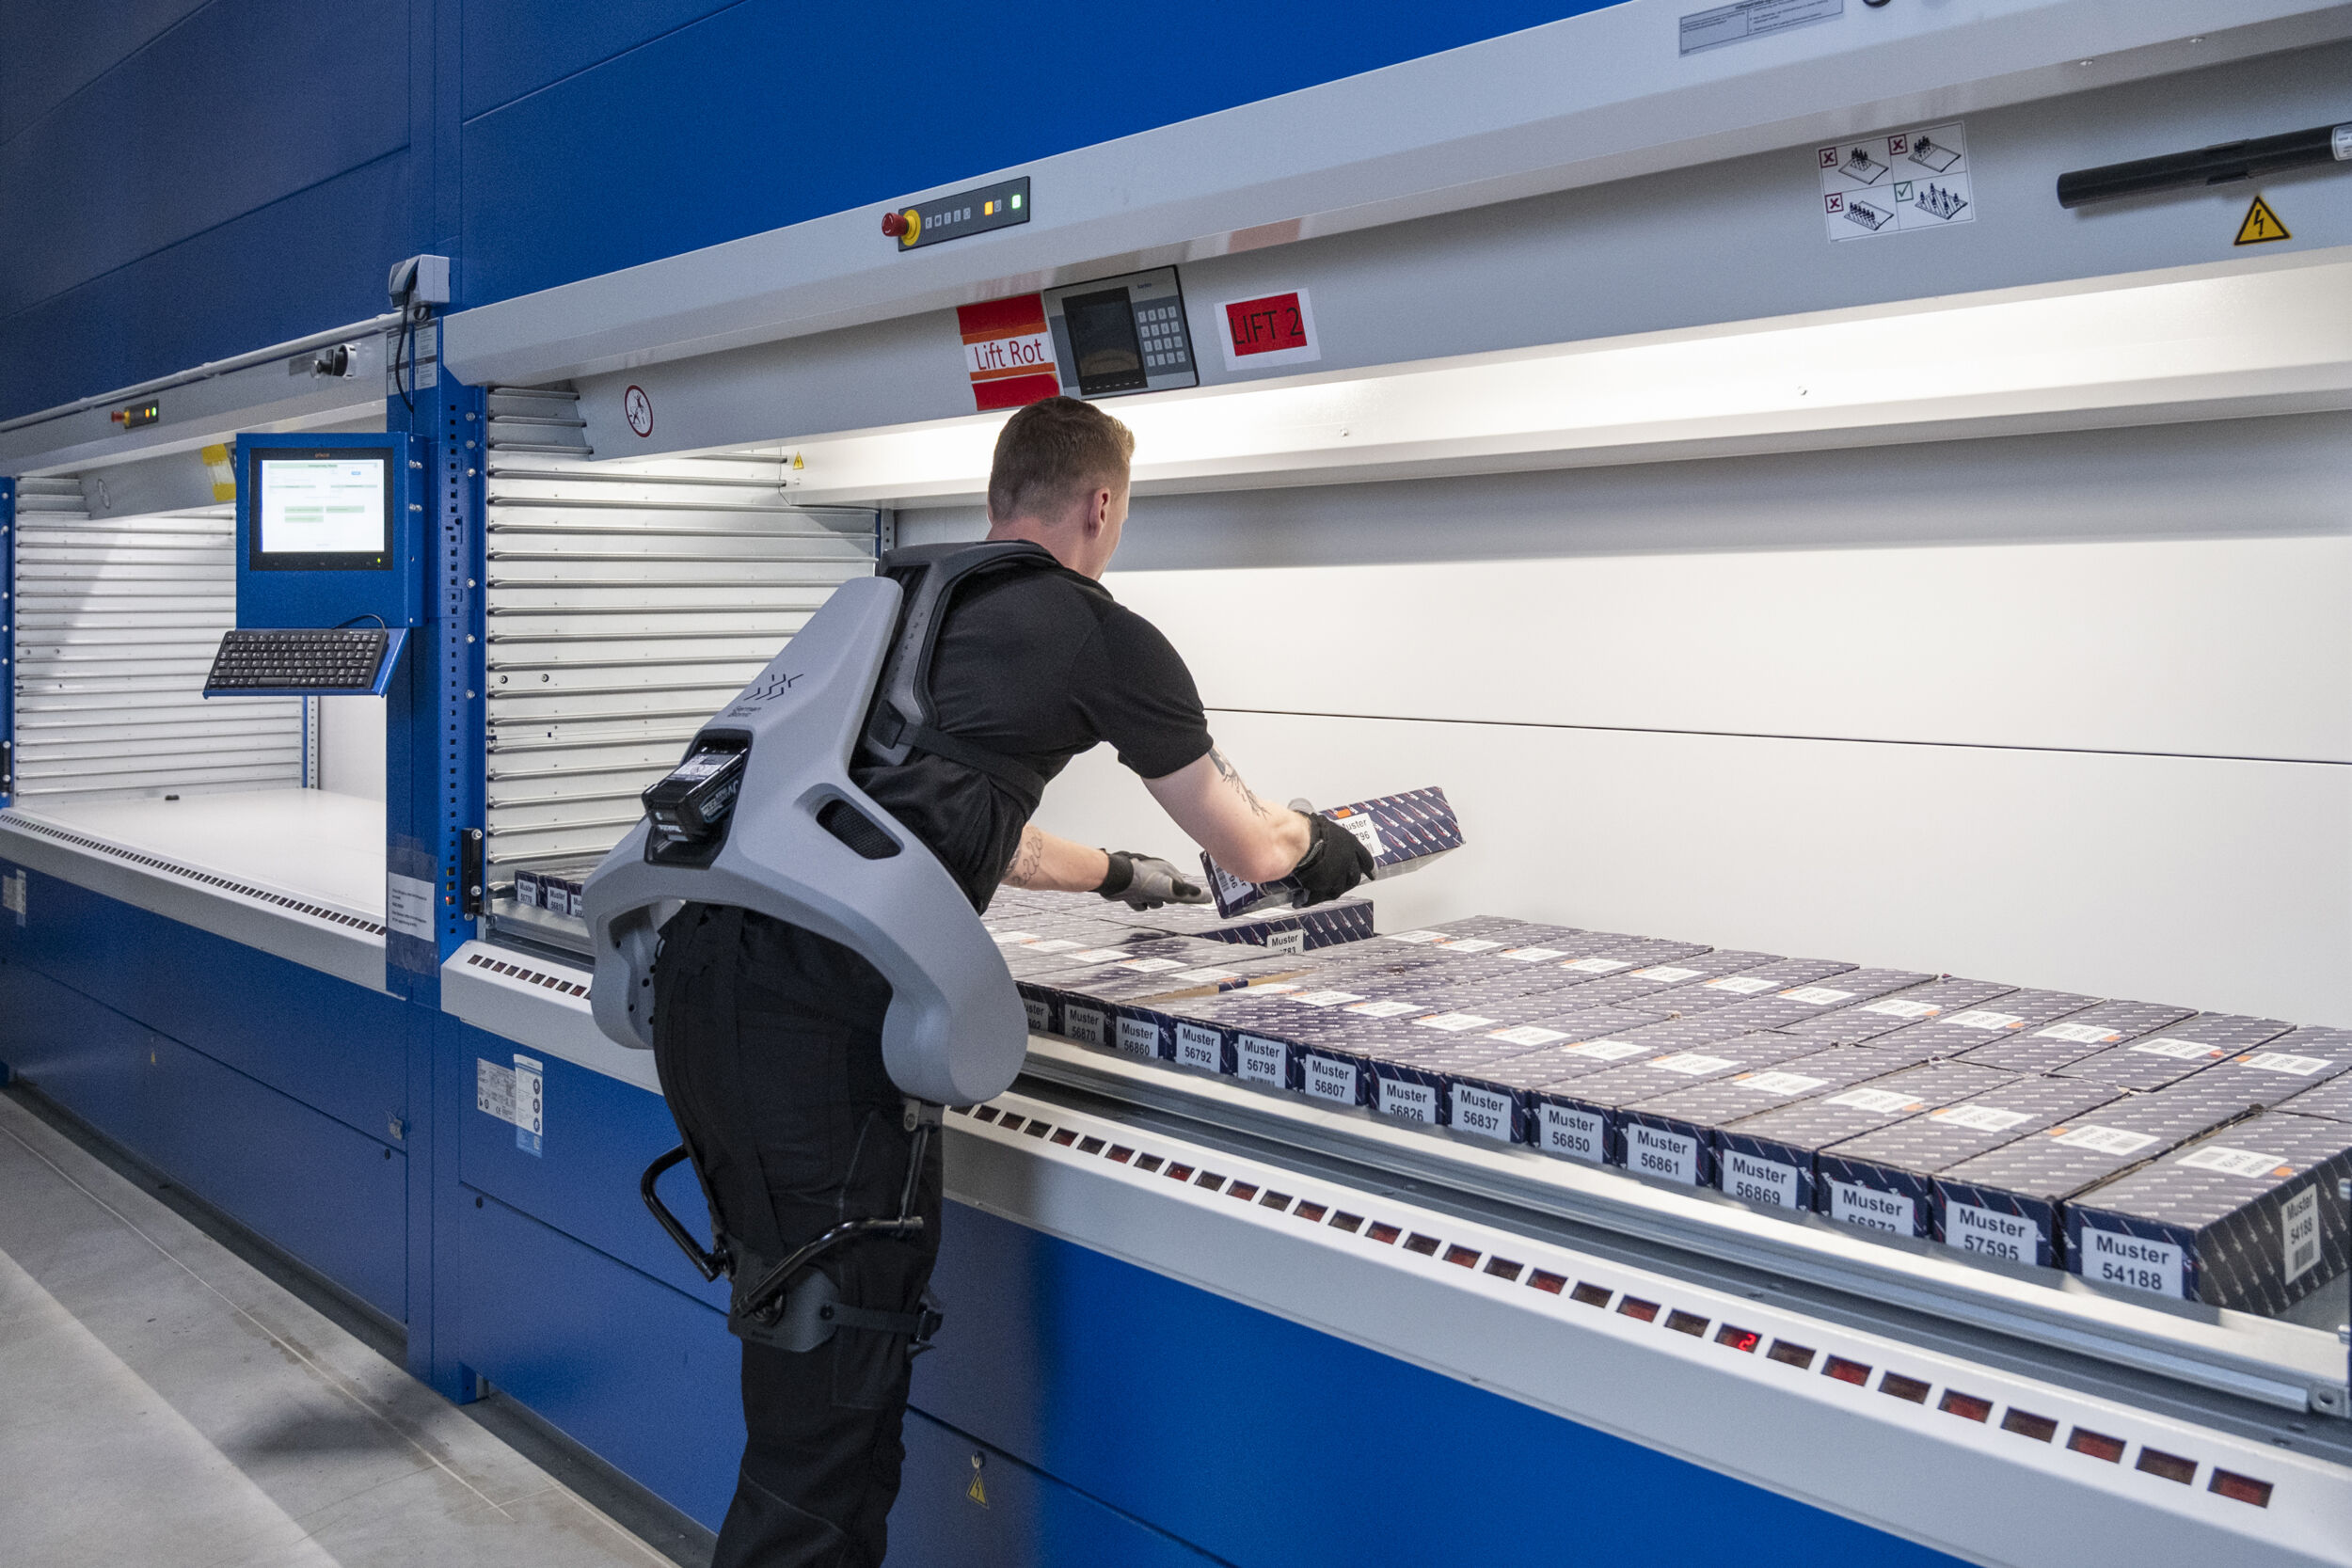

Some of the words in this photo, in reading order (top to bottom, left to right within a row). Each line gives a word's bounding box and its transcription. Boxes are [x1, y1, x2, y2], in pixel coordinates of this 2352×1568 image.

[1232, 310, 1279, 346] LIFT
[1290, 307, 1304, 337] 2
[974, 341, 1004, 372] Lift
[1009, 337, 1045, 366] Rot
[1355, 831, 1371, 841] 796
[519, 881, 533, 892] Muster
[1271, 934, 1298, 947] Muster
[1025, 1004, 1044, 1017] uster
[1070, 1009, 1099, 1025] Muster
[1072, 1026, 1096, 1041] 56870
[1121, 1023, 1153, 1039] Muster
[1183, 1028, 1216, 1047] Muster
[1123, 1040, 1150, 1055] 56860
[1184, 1045, 1212, 1064] 56792
[1245, 1038, 1280, 1059] Muster
[1247, 1057, 1277, 1076] 56798
[1312, 1060, 1349, 1082] Muster
[1314, 1079, 1345, 1099] 56807
[1387, 1083, 1427, 1104] Muster
[1460, 1089, 1504, 1113] Muster
[1390, 1103, 1423, 1122] 56826
[1463, 1110, 1499, 1132] 56837
[1549, 1109, 1595, 1133] Muster
[1552, 1131, 1590, 1153] 56850
[1637, 1131, 1688, 1156] Muster
[1641, 1153, 1679, 1175] 56861
[1732, 1157, 1787, 1185] Muster
[1736, 1181, 1781, 1205] 56869
[1843, 1189, 1903, 1217] Muster
[2286, 1194, 2313, 1220] Muster
[1959, 1208, 2026, 1238] Muster
[2290, 1216, 2313, 1244] 54188
[1963, 1233, 2019, 1261] 57595
[2096, 1234, 2169, 1265] Muster
[2101, 1264, 2163, 1291] 54188
[1739, 1333, 1756, 1352] 2
